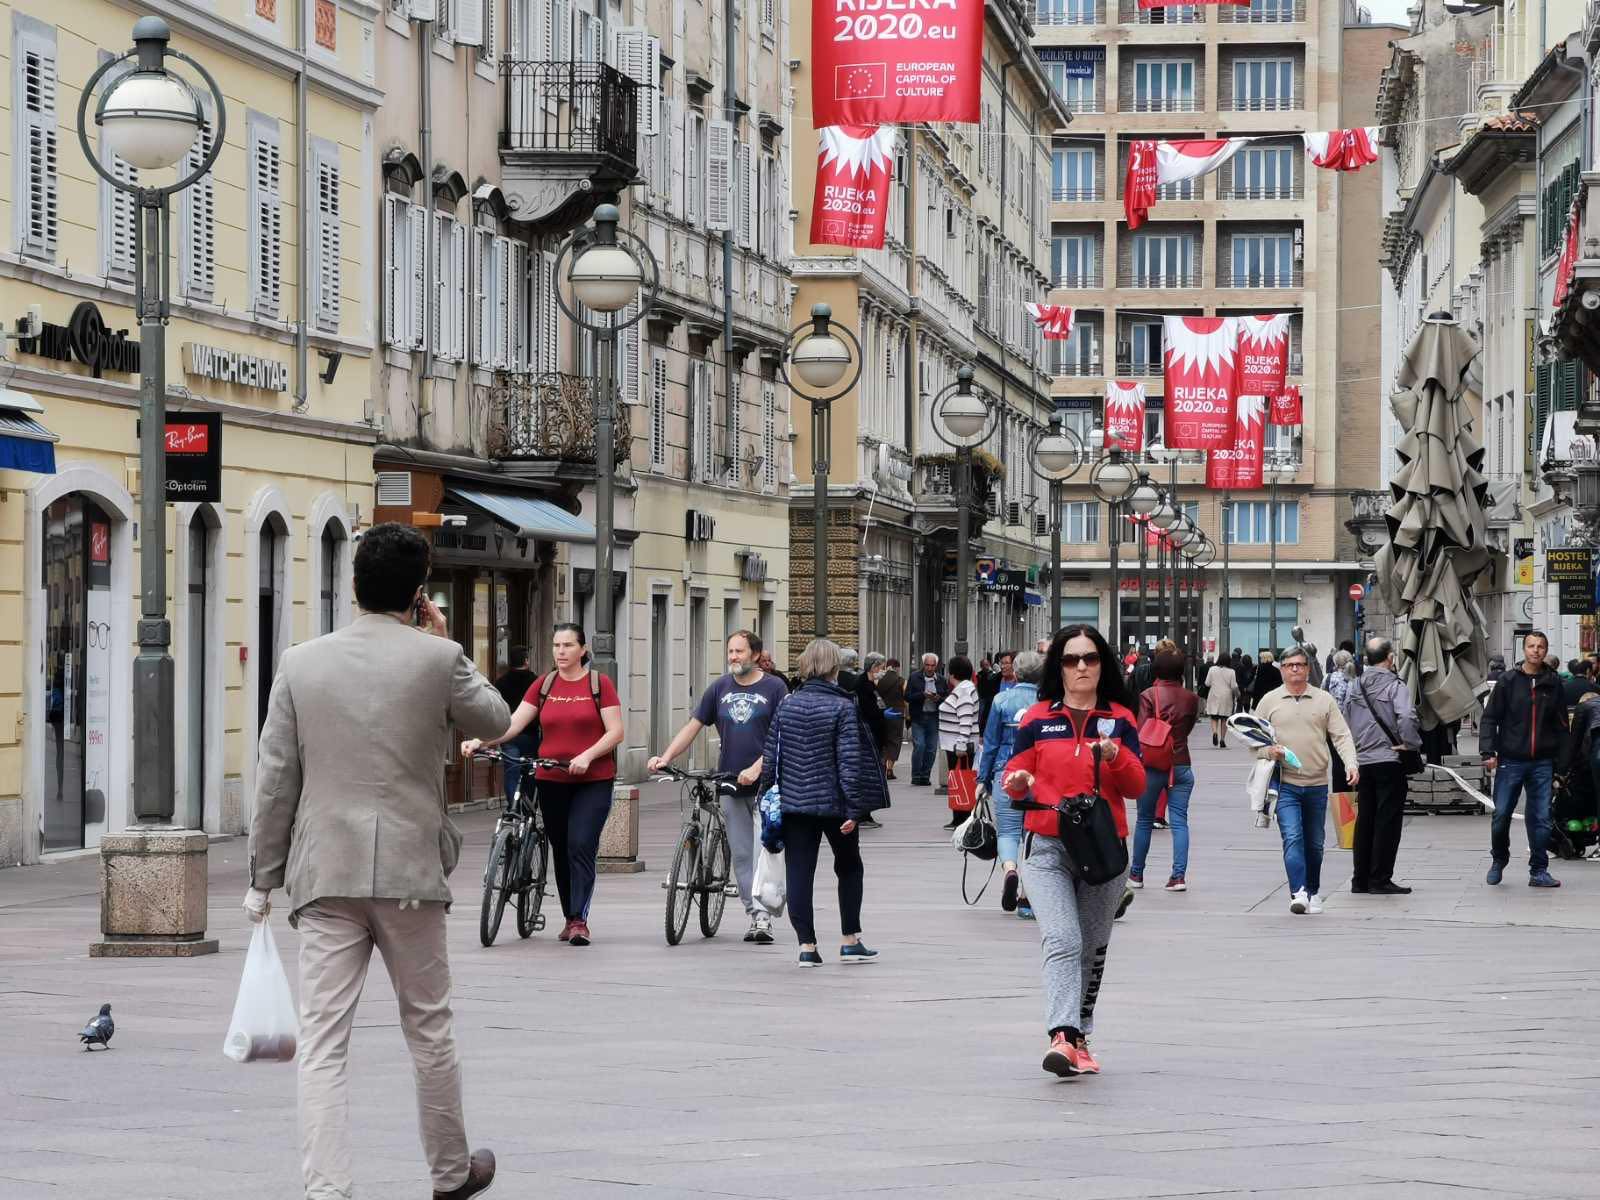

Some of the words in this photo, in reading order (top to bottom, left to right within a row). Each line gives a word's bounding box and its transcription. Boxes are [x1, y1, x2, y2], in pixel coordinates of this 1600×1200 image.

[833, 13, 957, 41] 2020.eu
[895, 62, 955, 72] EUROPEAN
[895, 74, 939, 85] CAPITAL
[940, 74, 957, 84] OF
[895, 87, 945, 97] CULTURE
[824, 185, 876, 202] RIJEKA
[1244, 355, 1281, 366] RIJEKA
[1174, 387, 1228, 400] RIJEKA
[1174, 400, 1228, 413] 2020.eu
[1109, 417, 1137, 426] RIJEKA
[1548, 551, 1589, 561] HOSTEL
[1553, 562, 1584, 570] RIJEKA
[1041, 725, 1067, 733] Zeus
